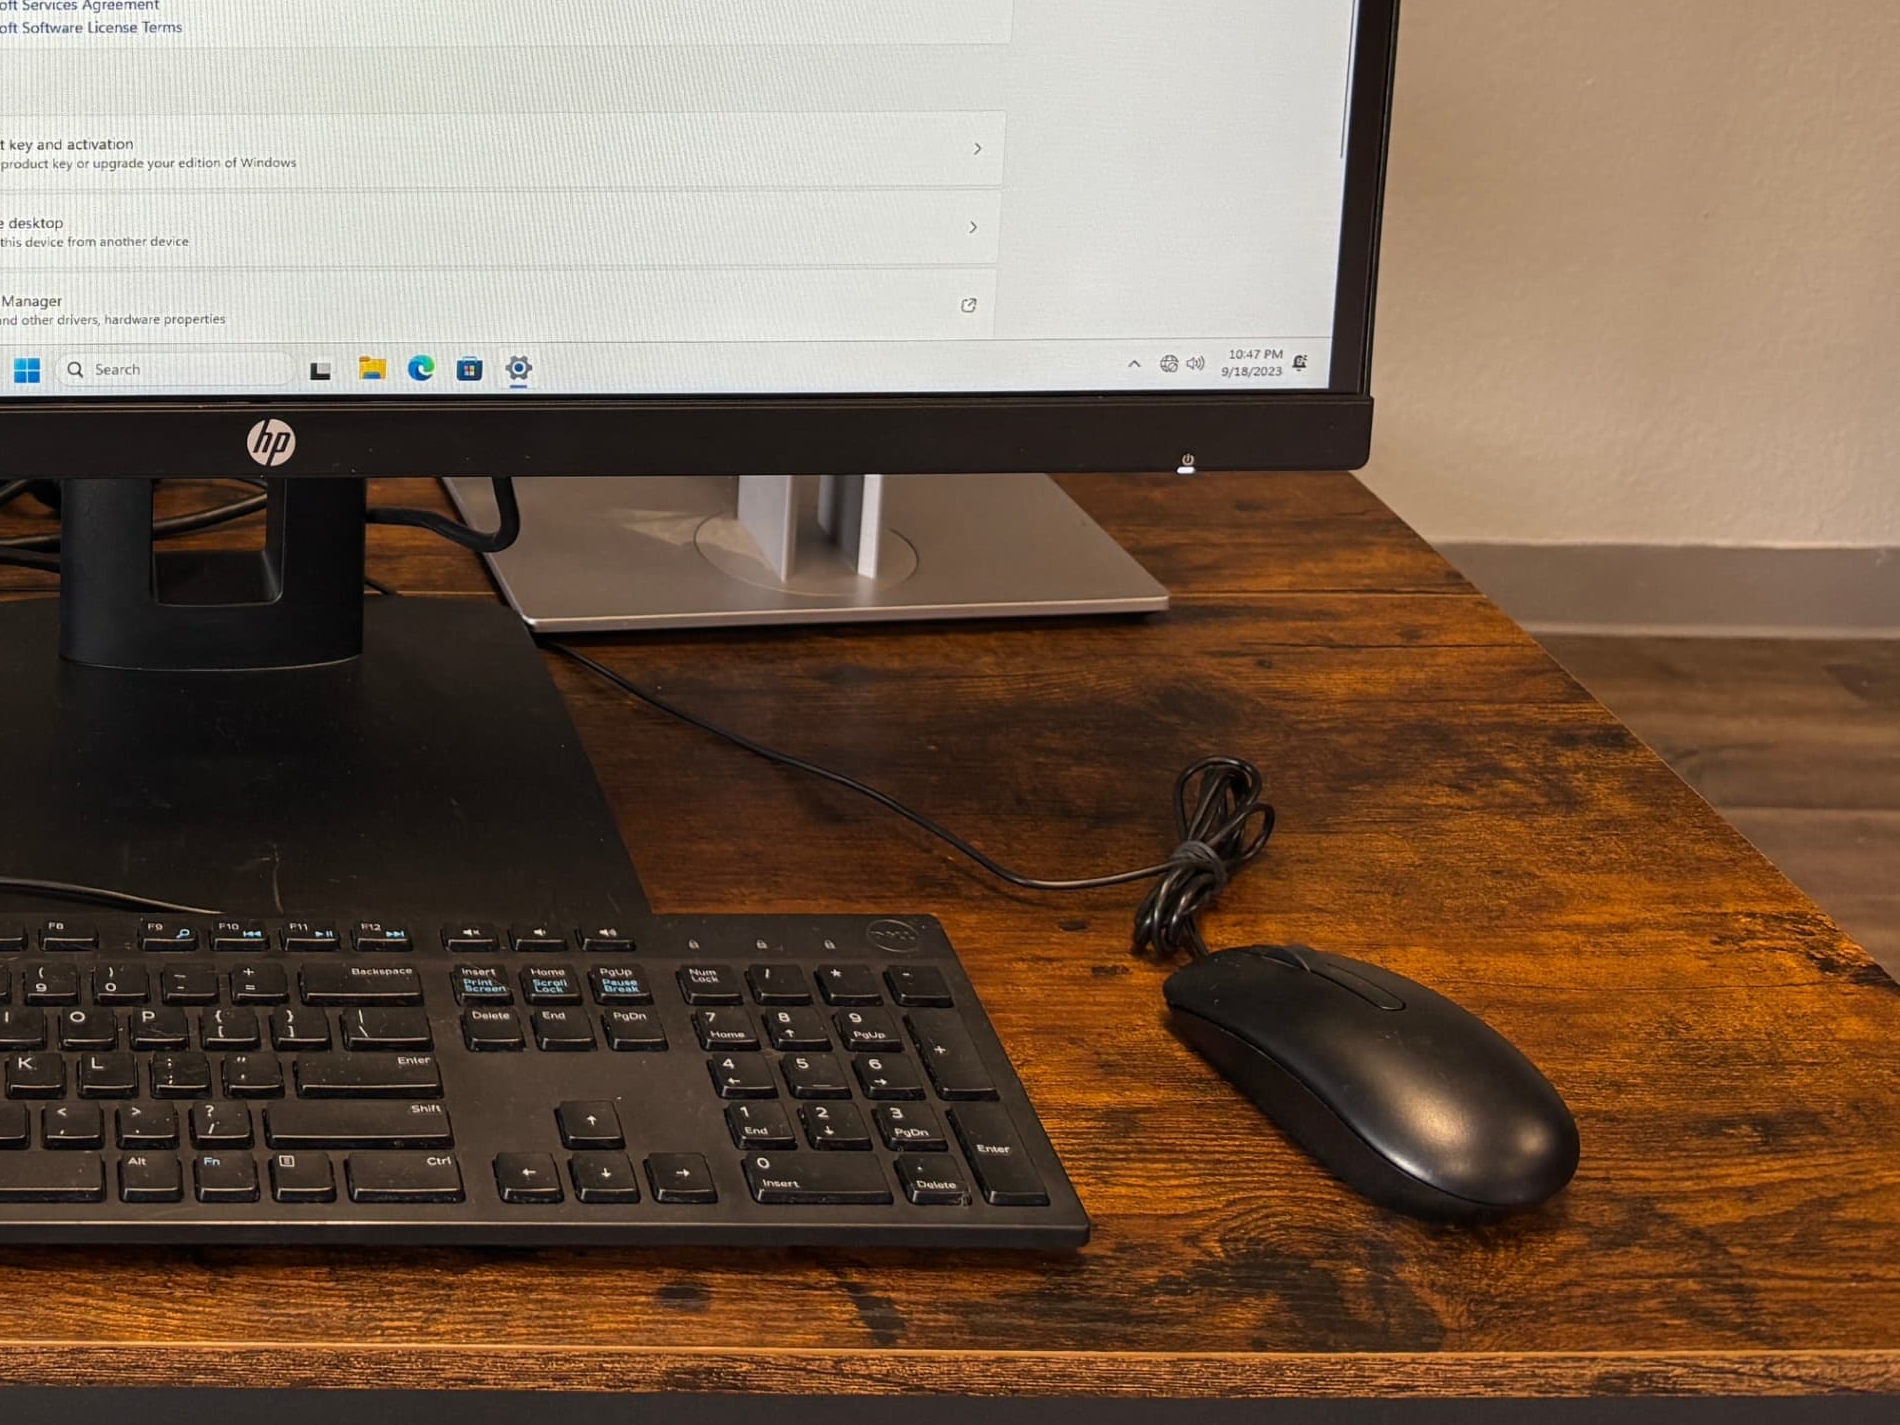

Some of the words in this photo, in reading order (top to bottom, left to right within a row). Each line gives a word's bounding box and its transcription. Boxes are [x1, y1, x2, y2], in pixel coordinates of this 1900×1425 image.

[8, 139, 34, 154] key
[36, 139, 63, 151] and
[66, 139, 134, 151] activation
[0, 158, 49, 173] product
[52, 158, 73, 172] key
[76, 159, 90, 169] or
[92, 158, 145, 173] upgrade
[146, 159, 176, 172] your
[177, 156, 221, 169] edition
[224, 156, 238, 169] of
[240, 156, 297, 169] Windows
[8, 217, 64, 232] desktop
[1229, 348, 1262, 360] 10:47
[1263, 348, 1284, 360] PM
[95, 362, 141, 377] Search
[1221, 365, 1284, 379] 9/18/2023
[351, 967, 413, 976] Backspace
[530, 968, 566, 977] Home
[599, 967, 633, 978] PgUp
[397, 1056, 431, 1066] Enter
[762, 1179, 800, 1189] Insert
